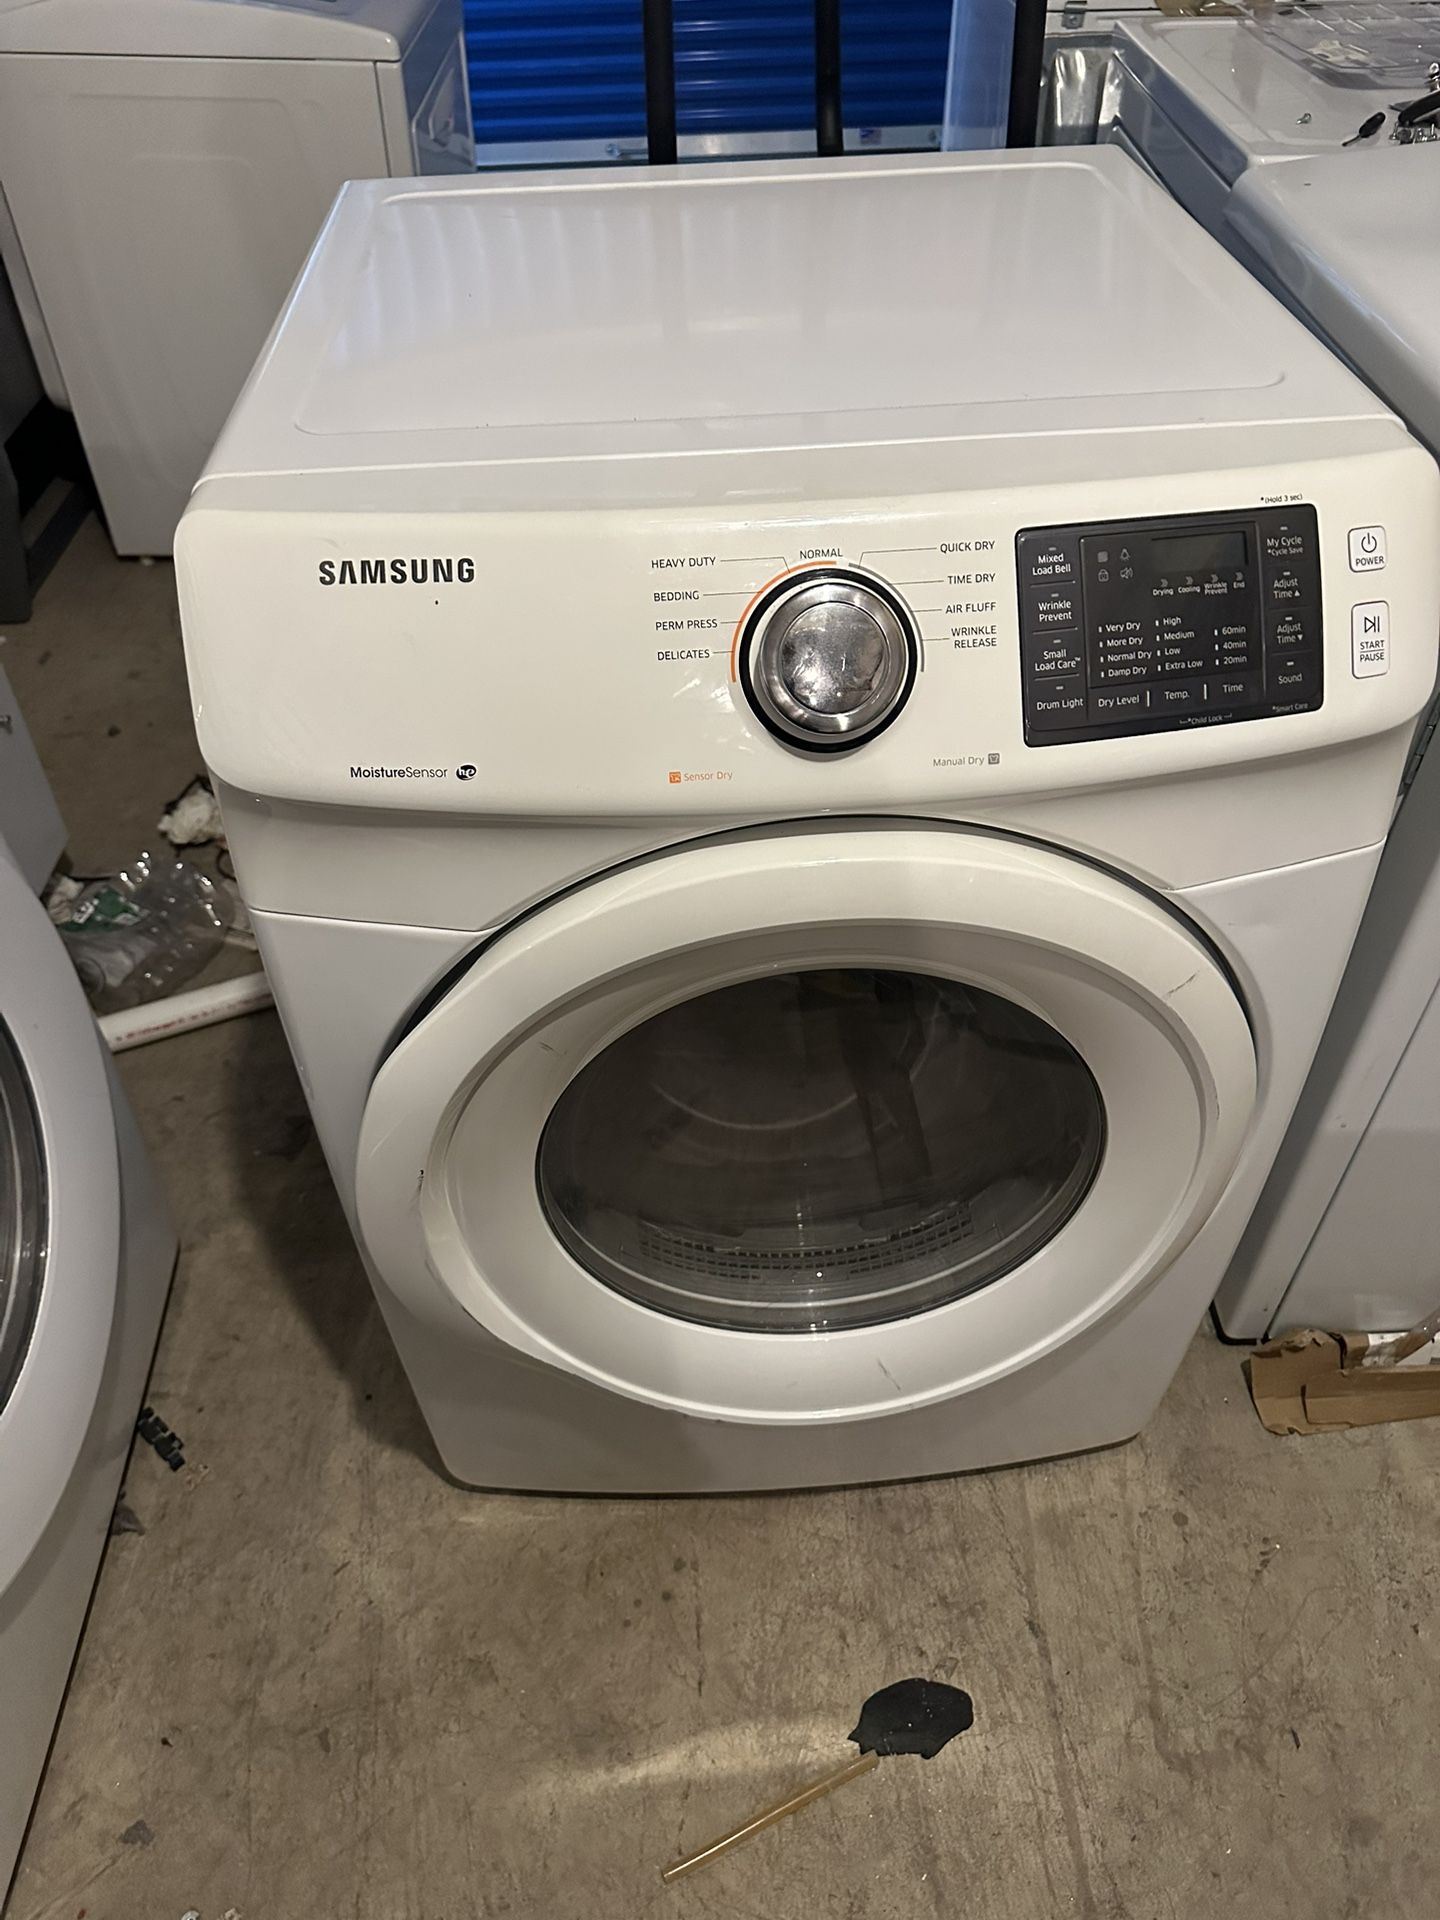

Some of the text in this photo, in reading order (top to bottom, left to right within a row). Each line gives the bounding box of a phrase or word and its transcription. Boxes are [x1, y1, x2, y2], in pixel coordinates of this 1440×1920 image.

[1267, 536, 1302, 547] My Cycle
[940, 541, 995, 554] QUICK DRY
[799, 548, 843, 559] NORMAL
[1038, 554, 1064, 563] Mixed
[651, 557, 716, 569] HEAVY DUTY
[1355, 556, 1384, 566] POWER
[318, 557, 475, 586] SAMSUNG
[1032, 564, 1071, 575] Load Bell
[947, 573, 996, 584] TIME DRY
[1273, 578, 1298, 589] Adjust
[1178, 585, 1200, 594] Cooling
[1204, 581, 1228, 589] Wrinkle
[653, 591, 699, 602] BEDDING
[1152, 588, 1173, 596] Drying
[1204, 587, 1228, 596] Prevent
[1273, 590, 1292, 599] Time
[945, 602, 996, 614] AIR FLUFF
[1038, 600, 1071, 611] Wrinkle
[1039, 611, 1072, 622] Prevent
[1163, 616, 1181, 626] High
[655, 619, 718, 631] PERM PRESS
[951, 625, 997, 636] WRINKLE
[1105, 621, 1140, 633] Very Dry
[1222, 626, 1246, 635] 60min
[1277, 623, 1302, 634] Adjust
[1164, 630, 1194, 640] Medium
[1277, 635, 1296, 644] Time
[954, 638, 997, 649] RELEASE
[1106, 636, 1143, 647] More Dry
[1222, 641, 1246, 650] 40min
[1360, 639, 1384, 650] START
[657, 649, 710, 661] DELICATES
[1043, 649, 1066, 660] Small
[1107, 651, 1152, 662] Normal Dry
[1360, 652, 1384, 662] PAUSE
[1034, 661, 1056, 671] Load
[1165, 660, 1203, 671] Extra Low
[1223, 656, 1247, 665] 20min
[1108, 667, 1147, 678] Damp Dry
[1278, 673, 1302, 684] Sound
[1222, 683, 1243, 693] Time
[1164, 689, 1190, 700] Temp.
[1036, 698, 1084, 710] Drum Light
[1098, 695, 1139, 708] Dry Level
[1208, 713, 1222, 722] Lock
[933, 755, 985, 767] Manual Dry
[350, 766, 448, 778] MoistureSensor
[683, 770, 733, 782] Sensor Dry
